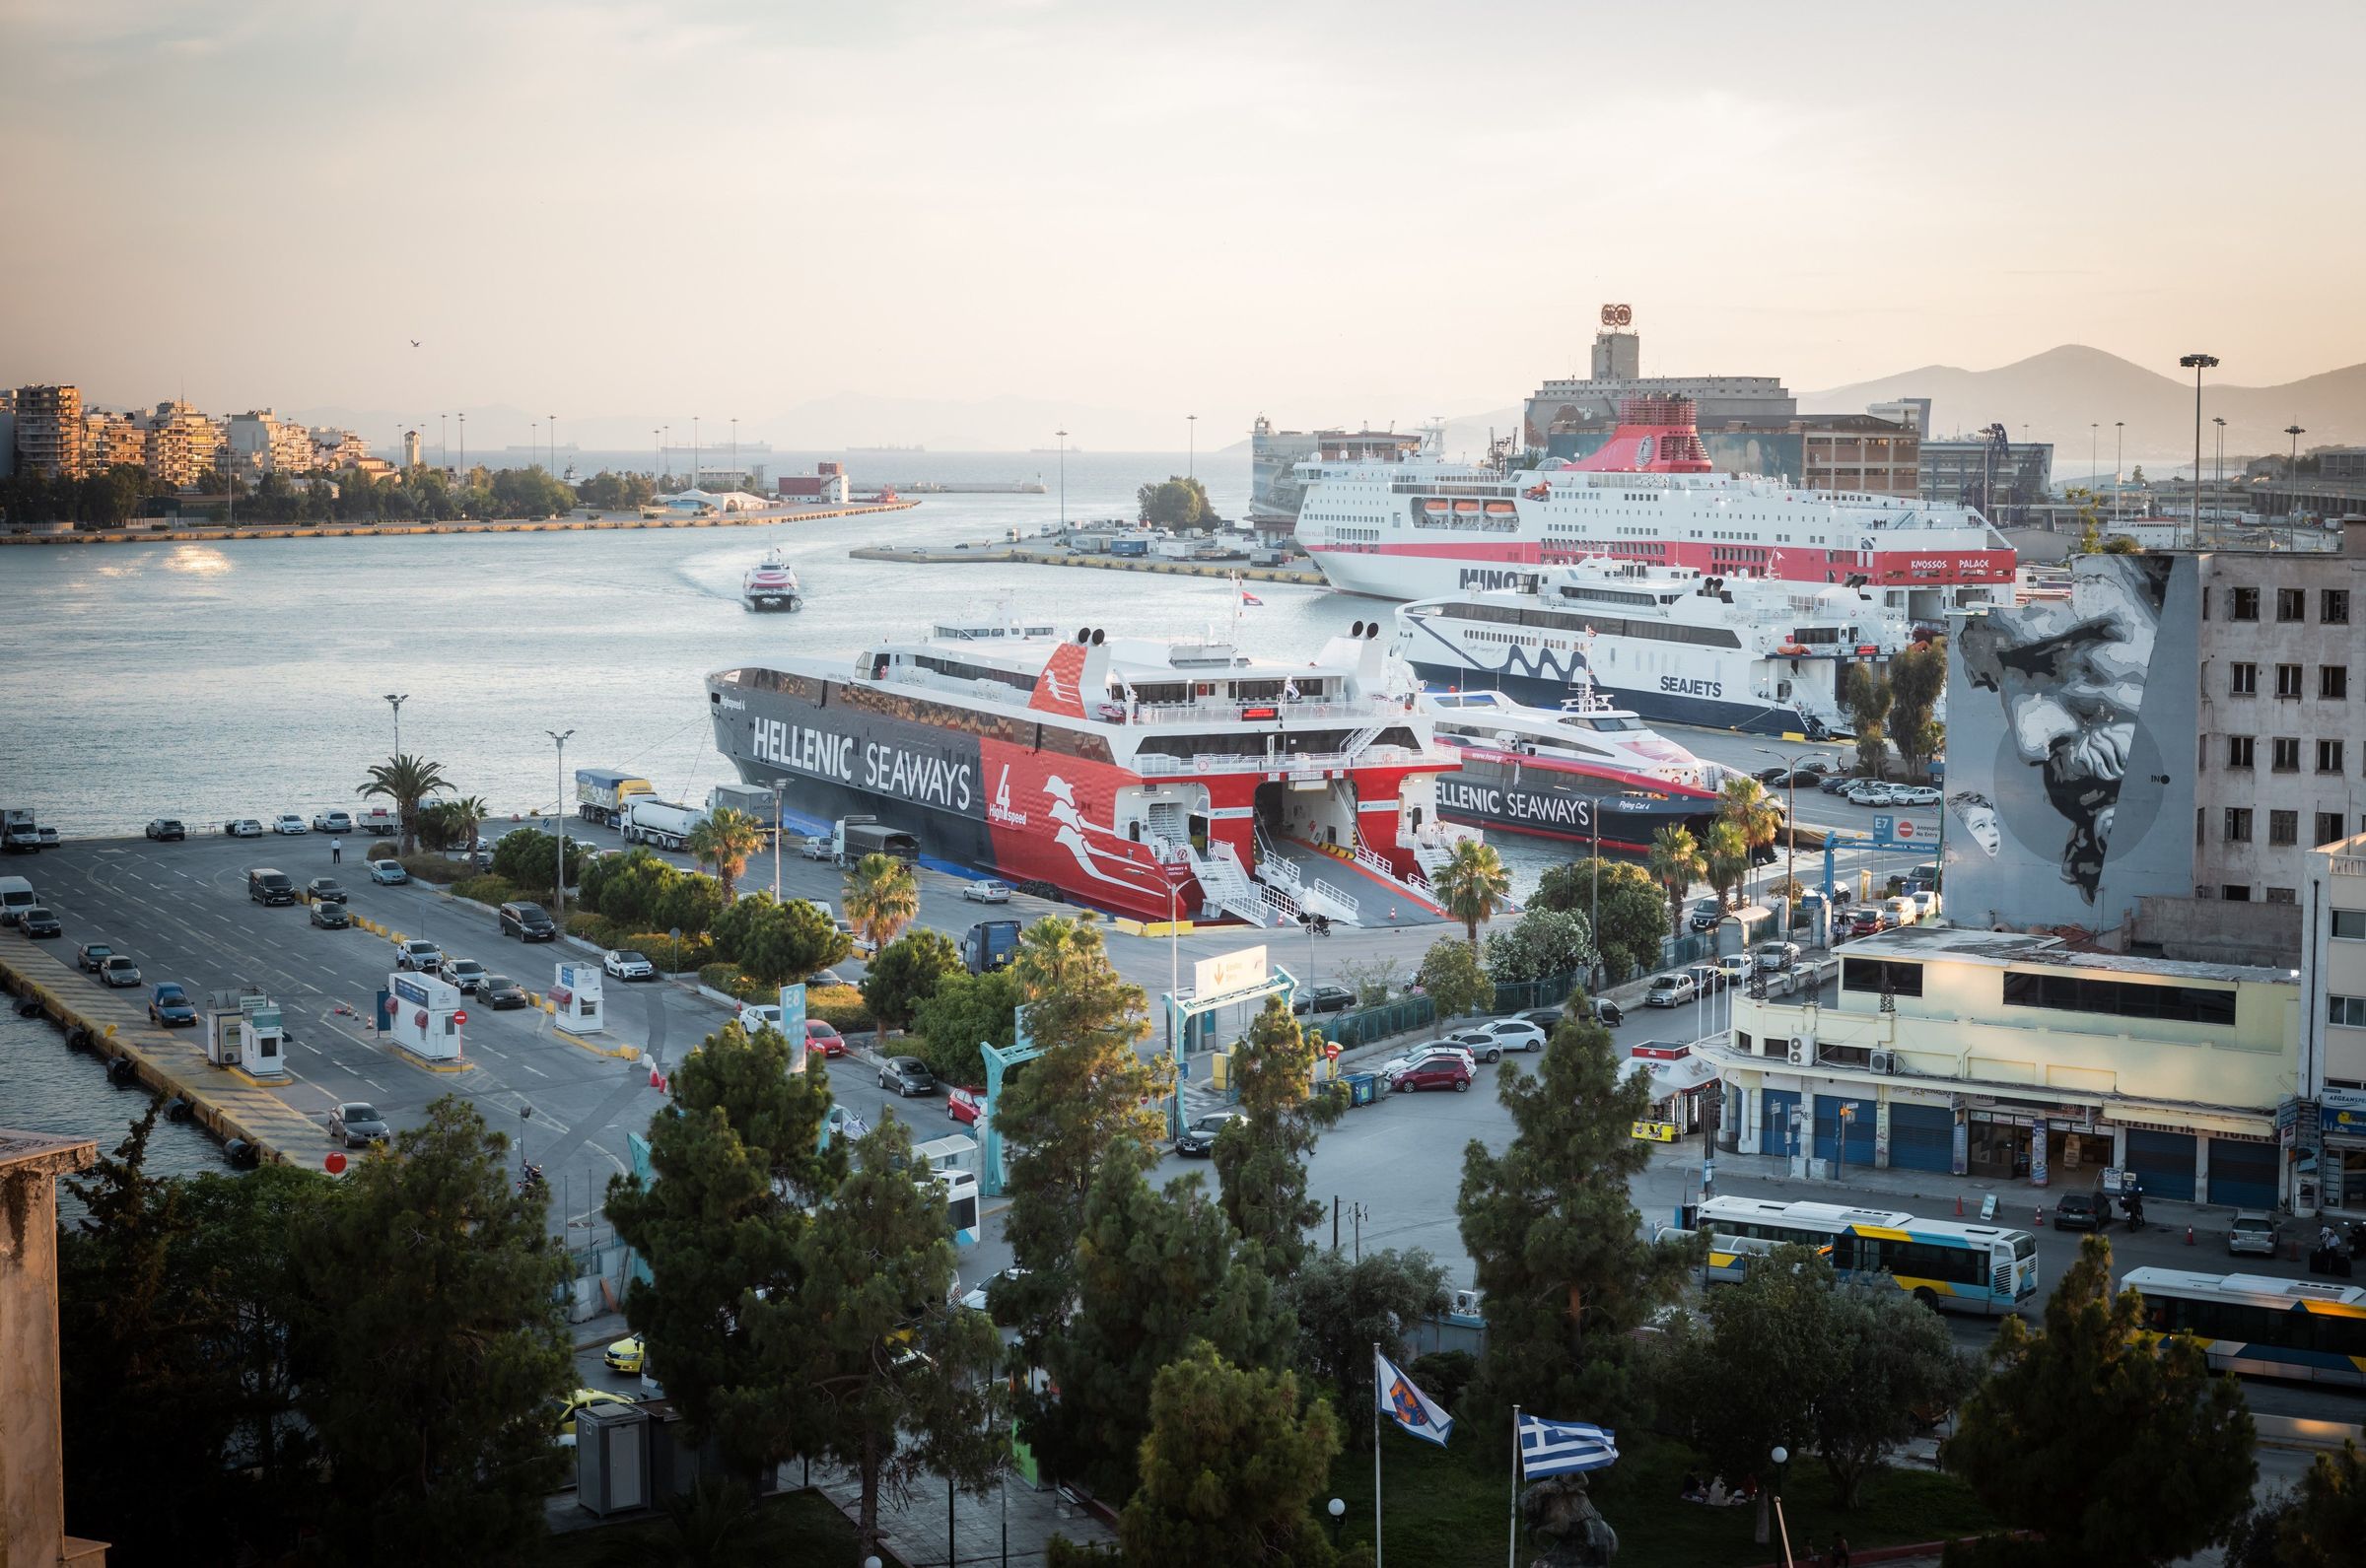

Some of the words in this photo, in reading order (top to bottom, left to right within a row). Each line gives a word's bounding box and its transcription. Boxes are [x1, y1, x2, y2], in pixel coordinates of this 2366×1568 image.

[1911, 560, 1948, 570] KNOSSOS
[1958, 559, 1989, 569] PALACE
[1659, 676, 1722, 698] SEAJETS
[752, 716, 853, 781] HELLENIC
[865, 742, 971, 811] SEAWAYS
[996, 764, 1010, 821] 4
[1435, 781, 1500, 814] ELLENIC
[1507, 791, 1590, 826] SEAWAYS
[1875, 817, 1889, 829] E7
[786, 989, 800, 1008] E8
